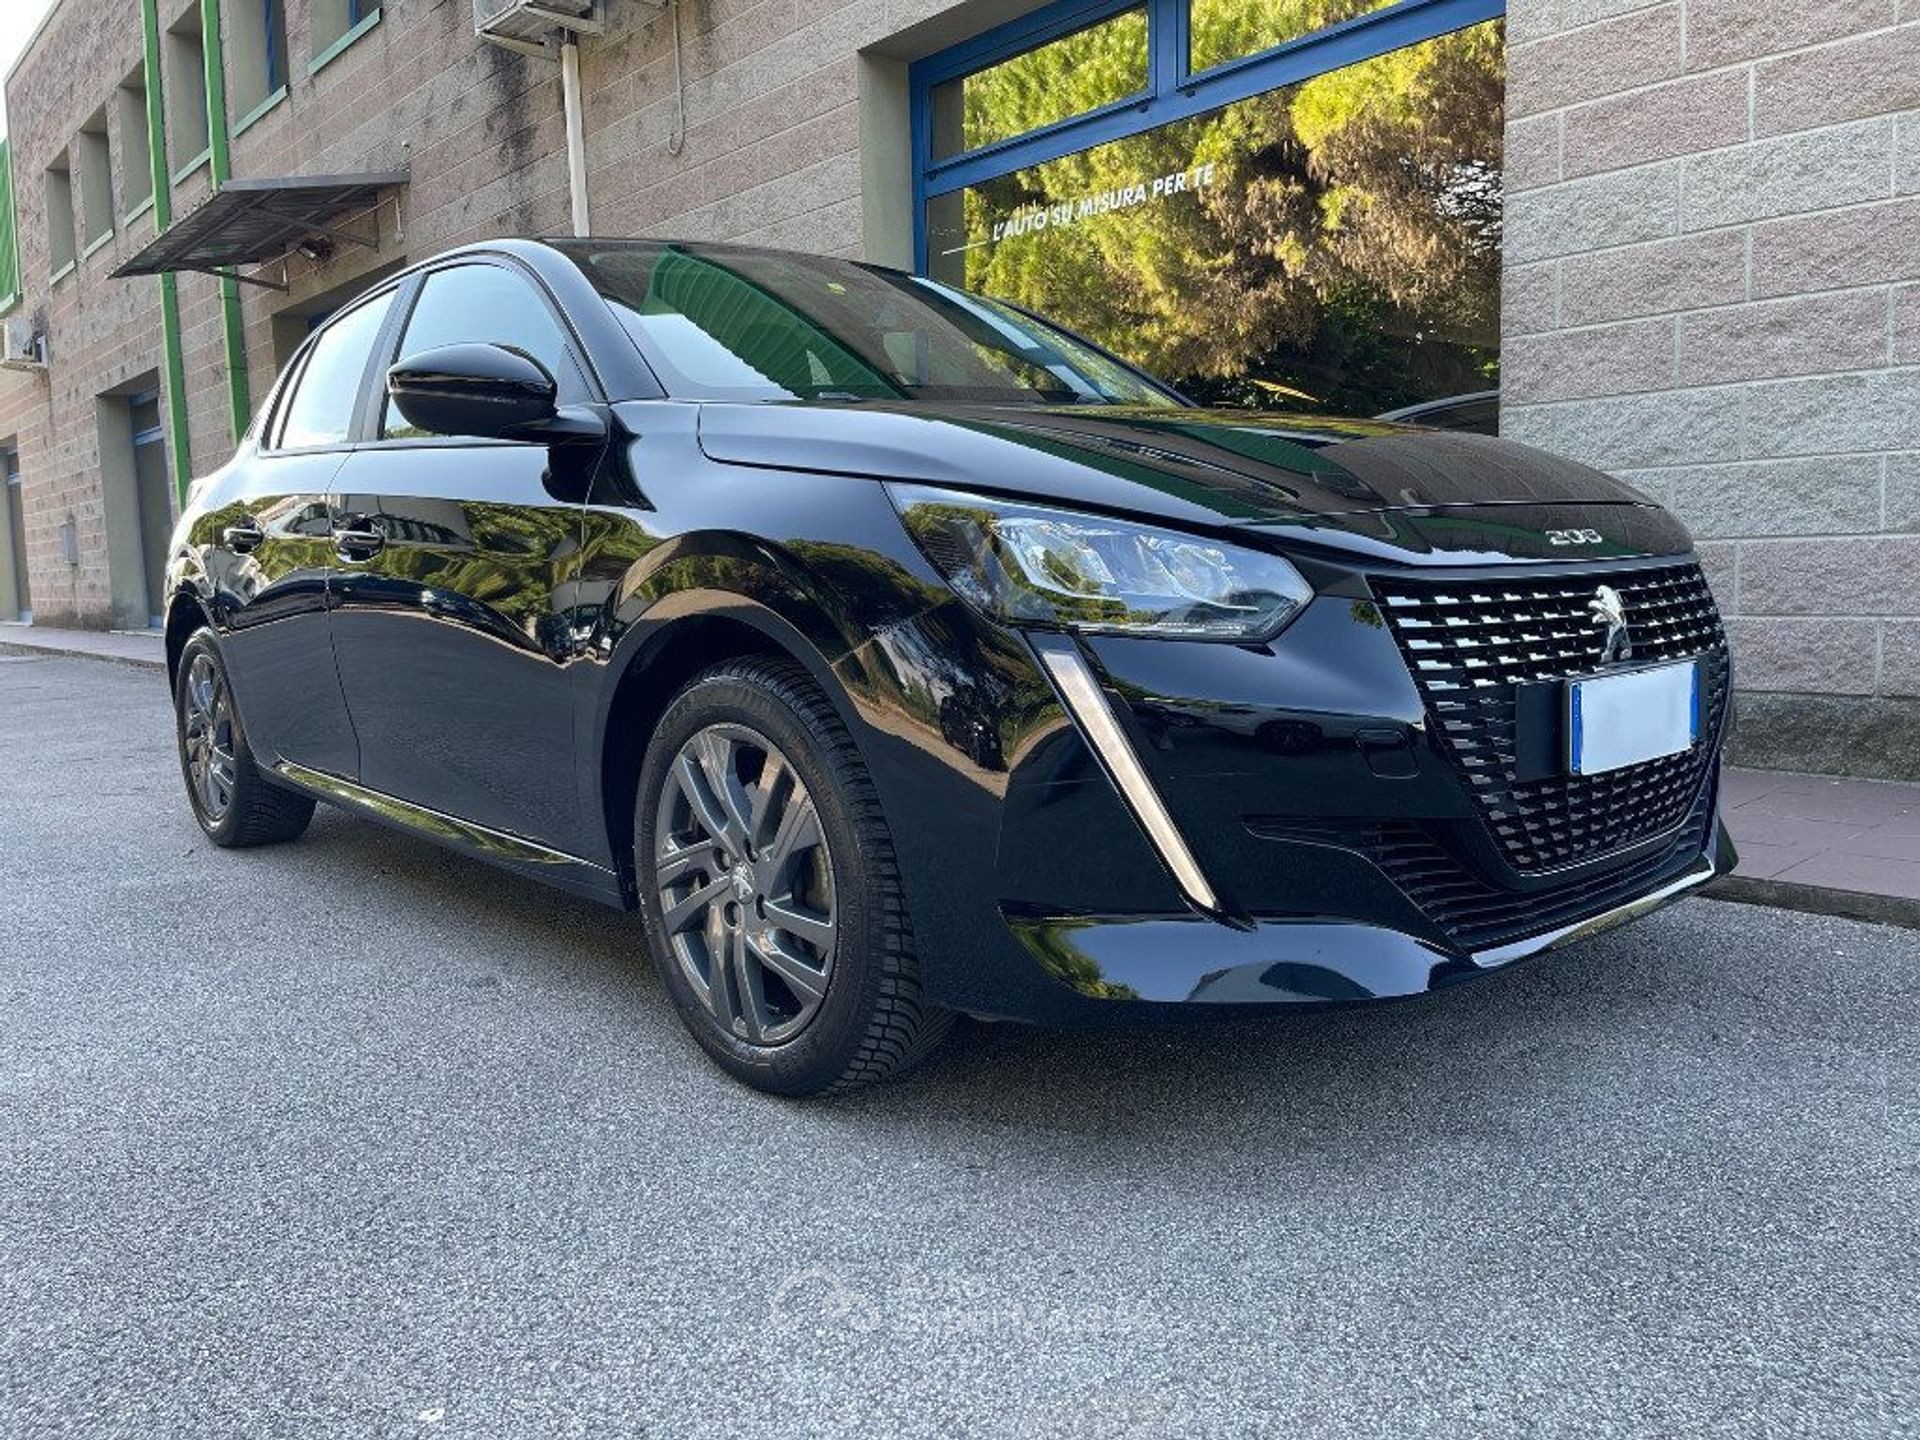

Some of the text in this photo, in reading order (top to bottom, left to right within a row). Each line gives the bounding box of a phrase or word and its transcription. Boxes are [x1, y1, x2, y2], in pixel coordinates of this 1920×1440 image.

[993, 163, 1214, 241] L'AUTO SU MISURA PER TE
